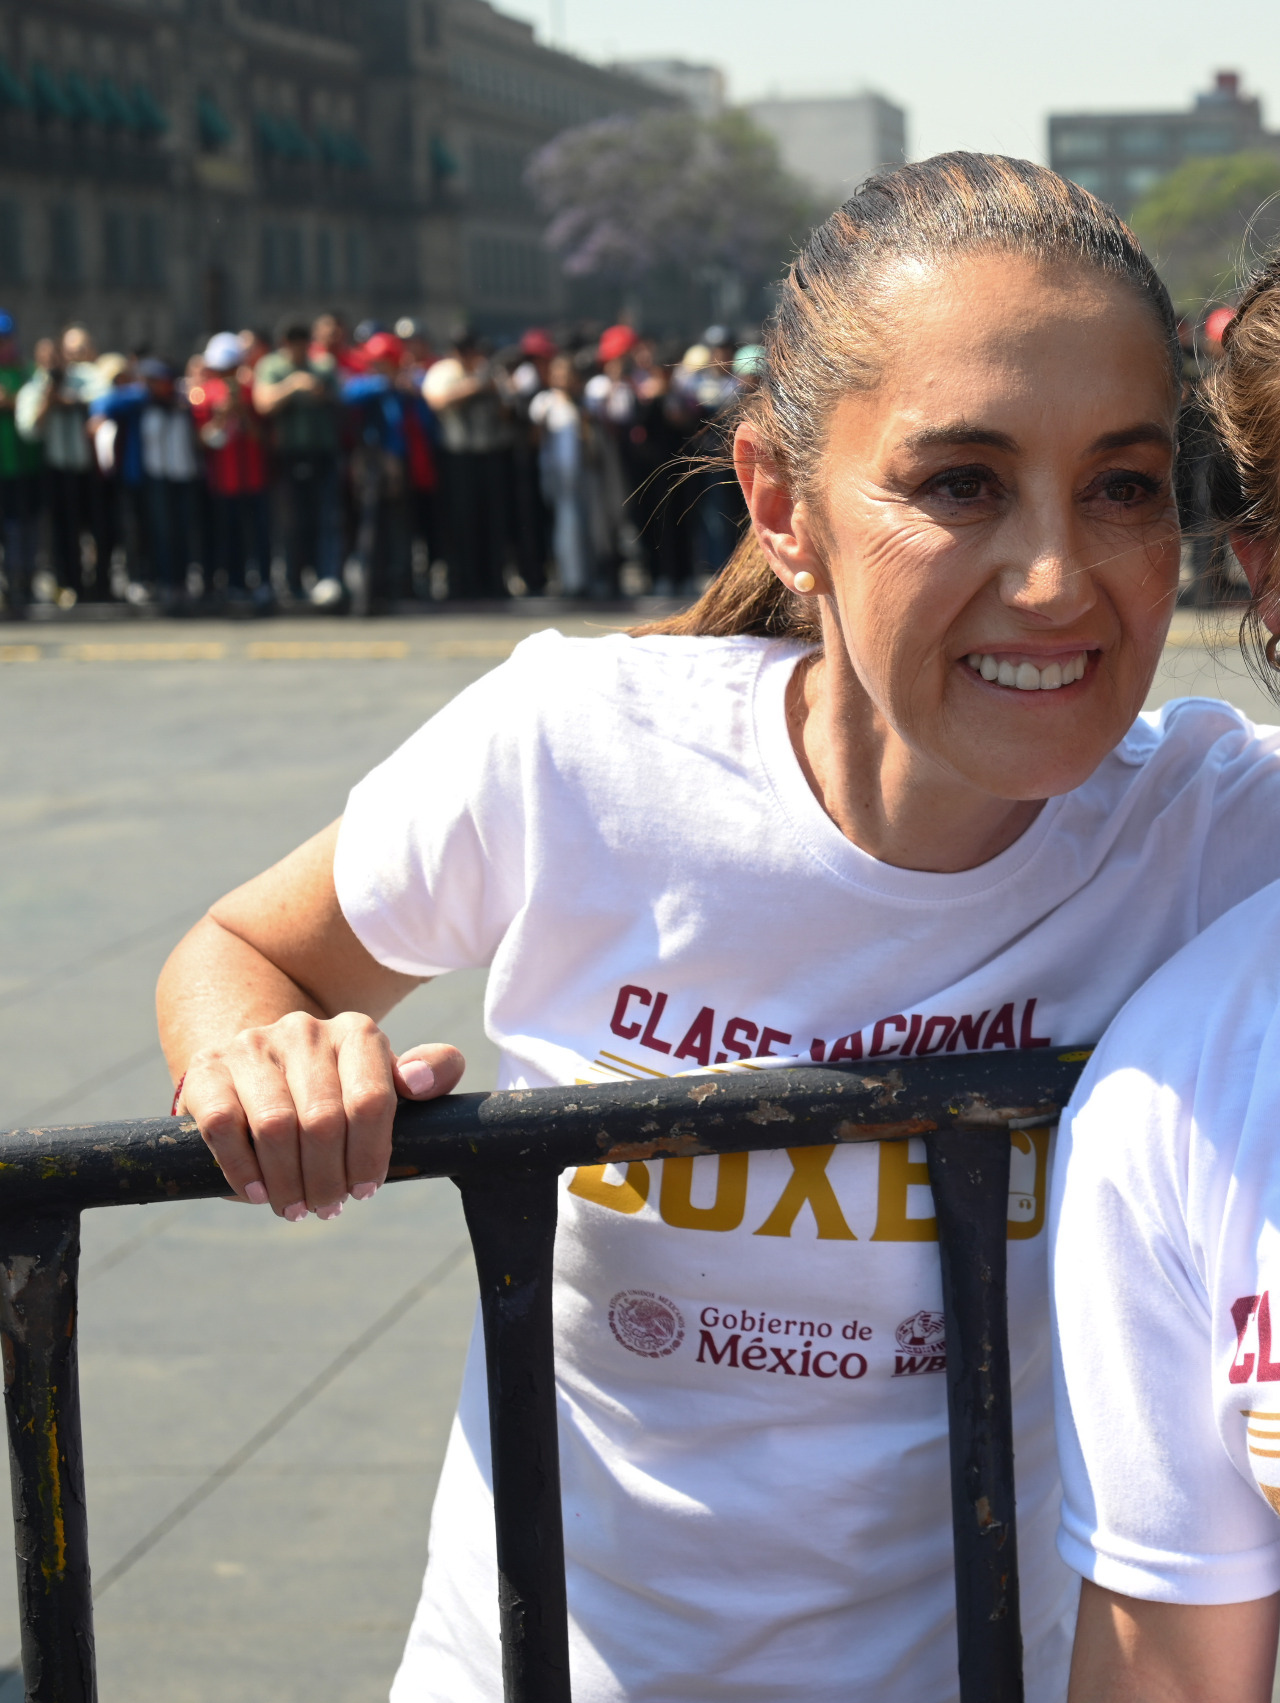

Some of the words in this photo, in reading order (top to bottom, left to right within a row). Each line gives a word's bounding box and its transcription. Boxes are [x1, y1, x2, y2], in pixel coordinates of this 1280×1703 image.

[700, 1307, 832, 1339] Gobierno
[842, 1320, 873, 1341] de
[696, 1330, 867, 1380] México
